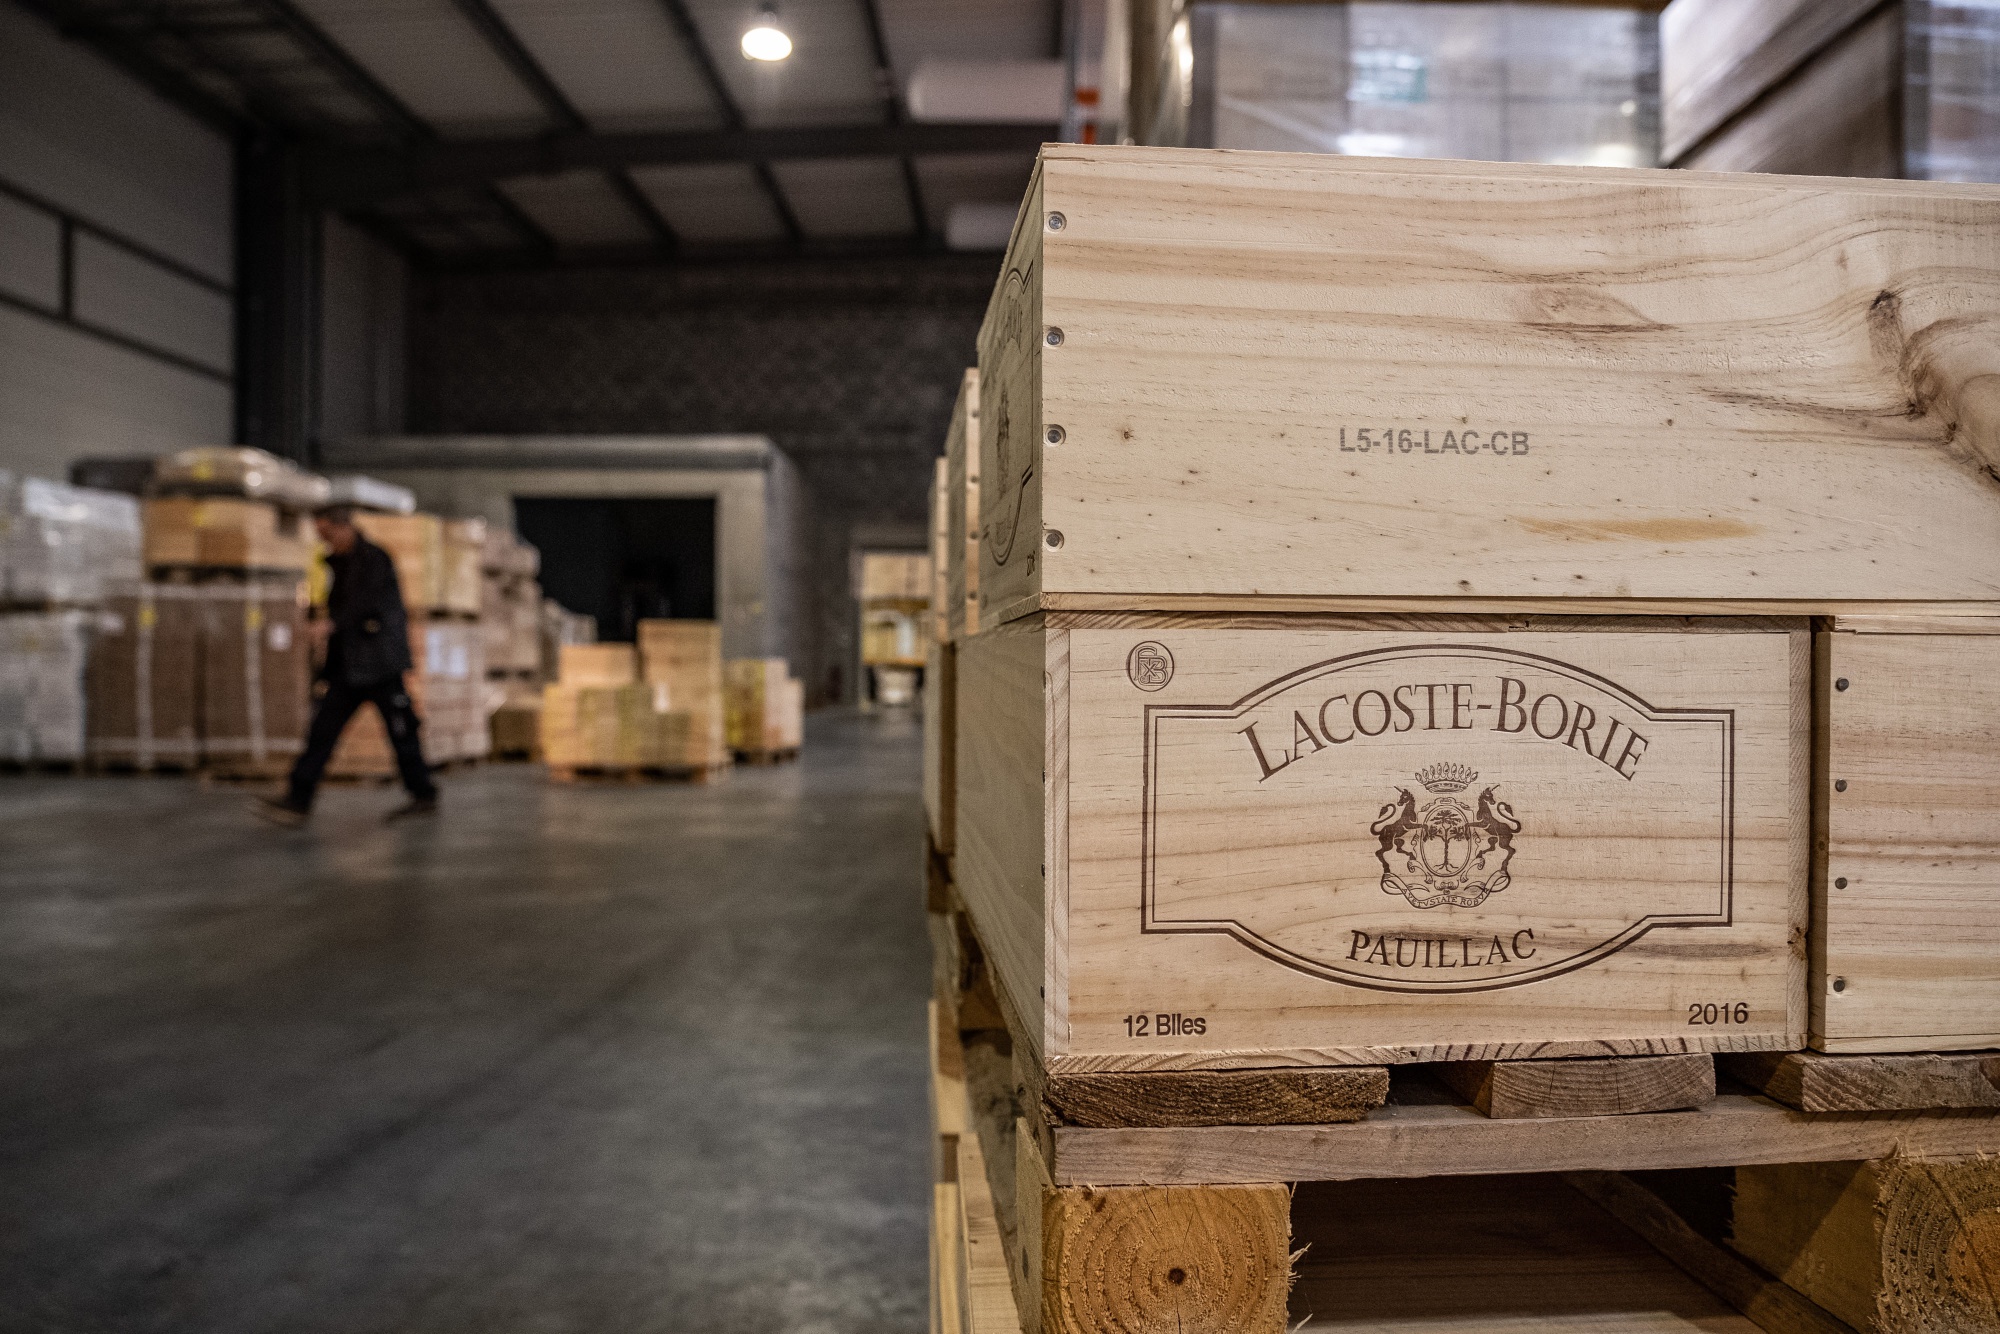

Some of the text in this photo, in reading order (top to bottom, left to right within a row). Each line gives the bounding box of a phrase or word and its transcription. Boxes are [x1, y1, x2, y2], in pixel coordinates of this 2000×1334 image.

[1338, 427, 1530, 456] L5-16-LAC-CB
[1237, 675, 1651, 784] LACOSTE-BORIE
[1345, 928, 1537, 968] PAUILLAC
[1122, 1014, 1149, 1038] 12
[1687, 1002, 1749, 1026] 2016
